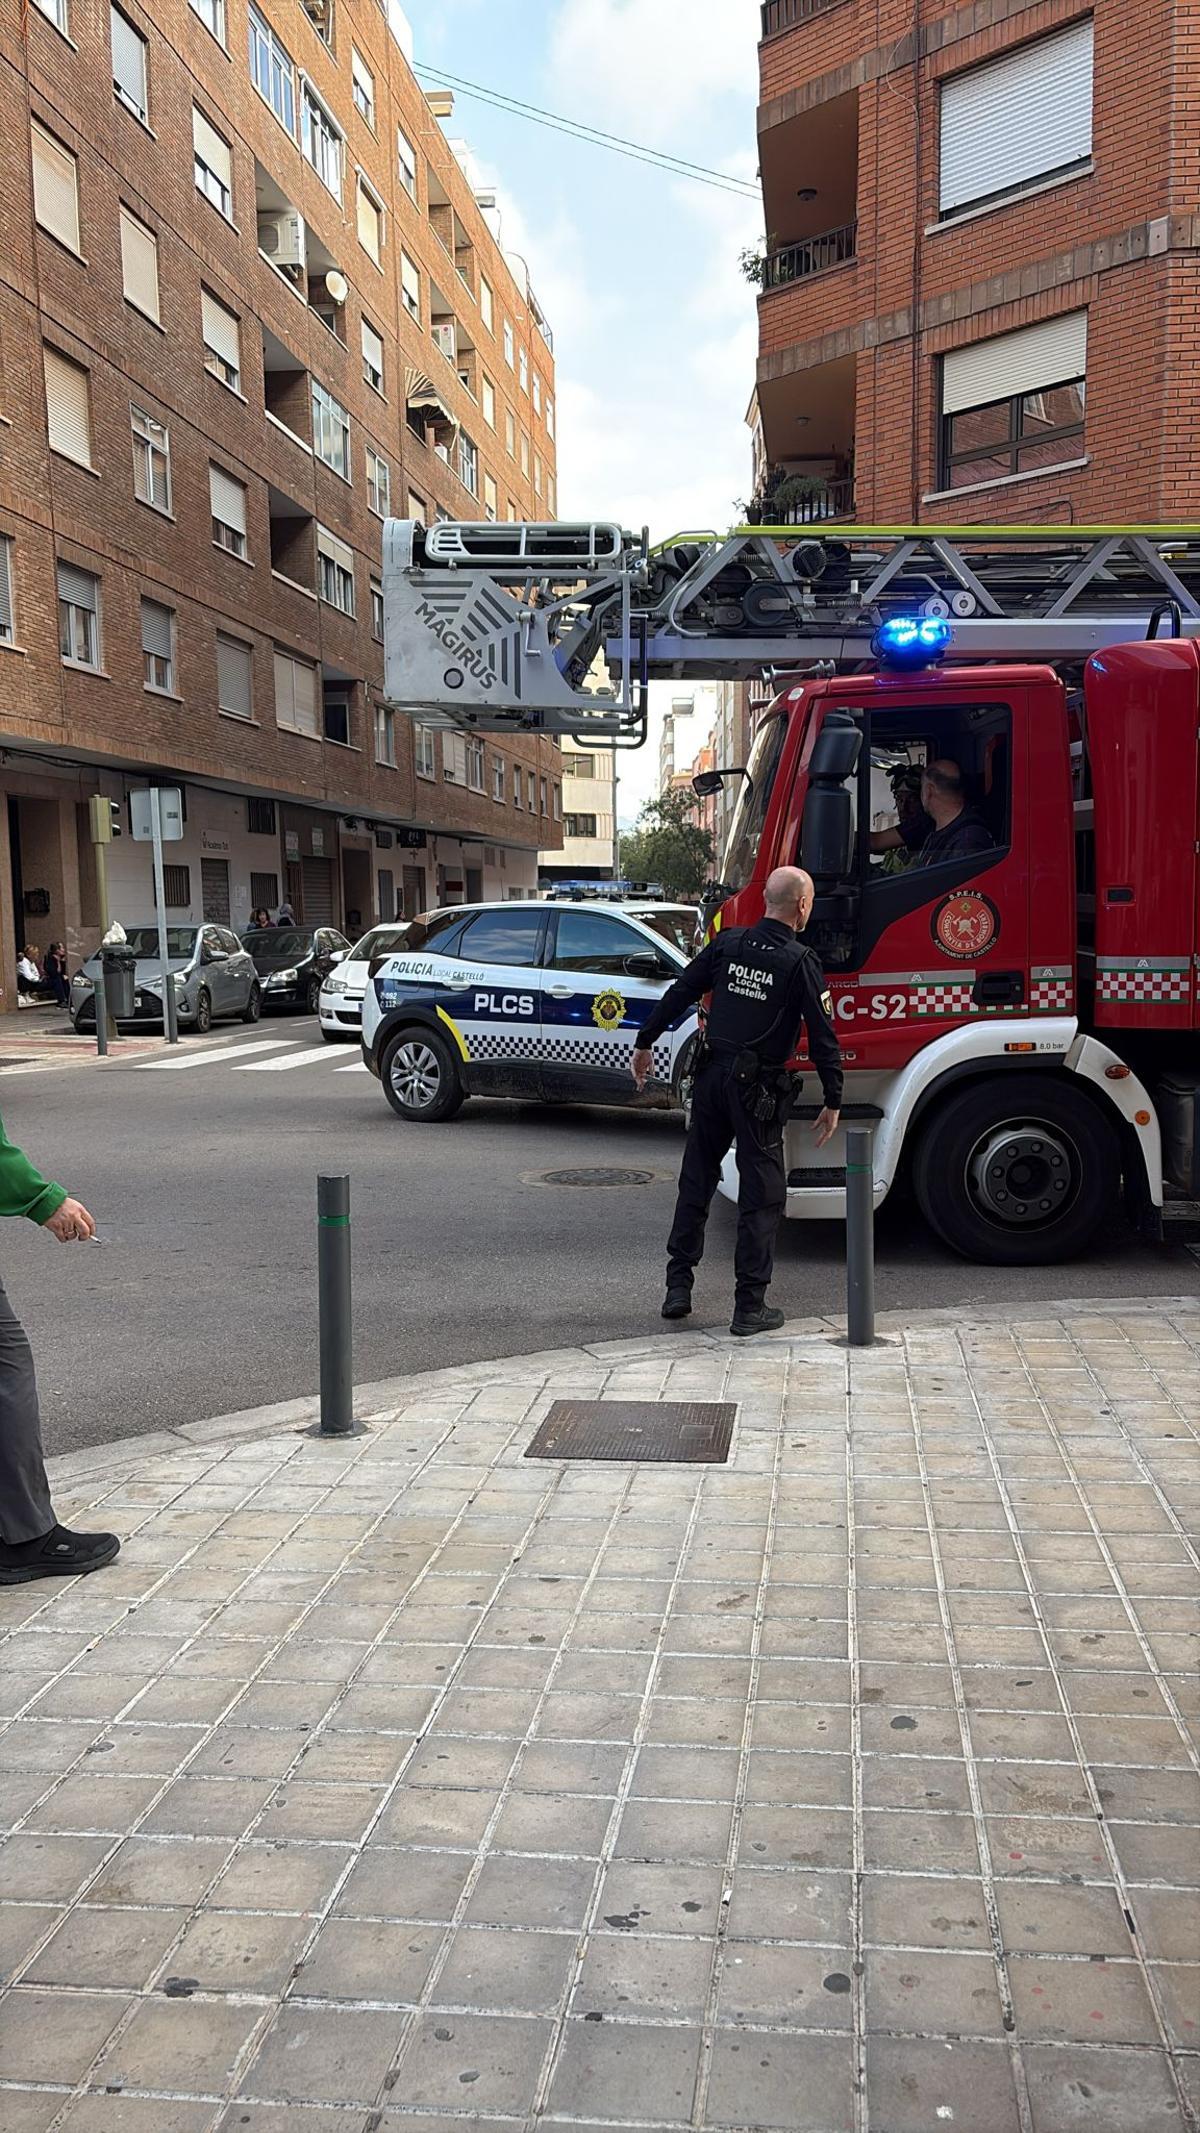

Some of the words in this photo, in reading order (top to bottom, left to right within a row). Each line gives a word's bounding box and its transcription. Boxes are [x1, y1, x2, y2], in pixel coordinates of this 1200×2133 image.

[415, 601, 498, 689] MAGIRUS
[949, 890, 983, 900] S.P.E.I.S.
[728, 962, 773, 986] POLICIA
[736, 977, 761, 991] LOCAL
[728, 982, 767, 1001] Castelló
[474, 993, 534, 1015] PLCS
